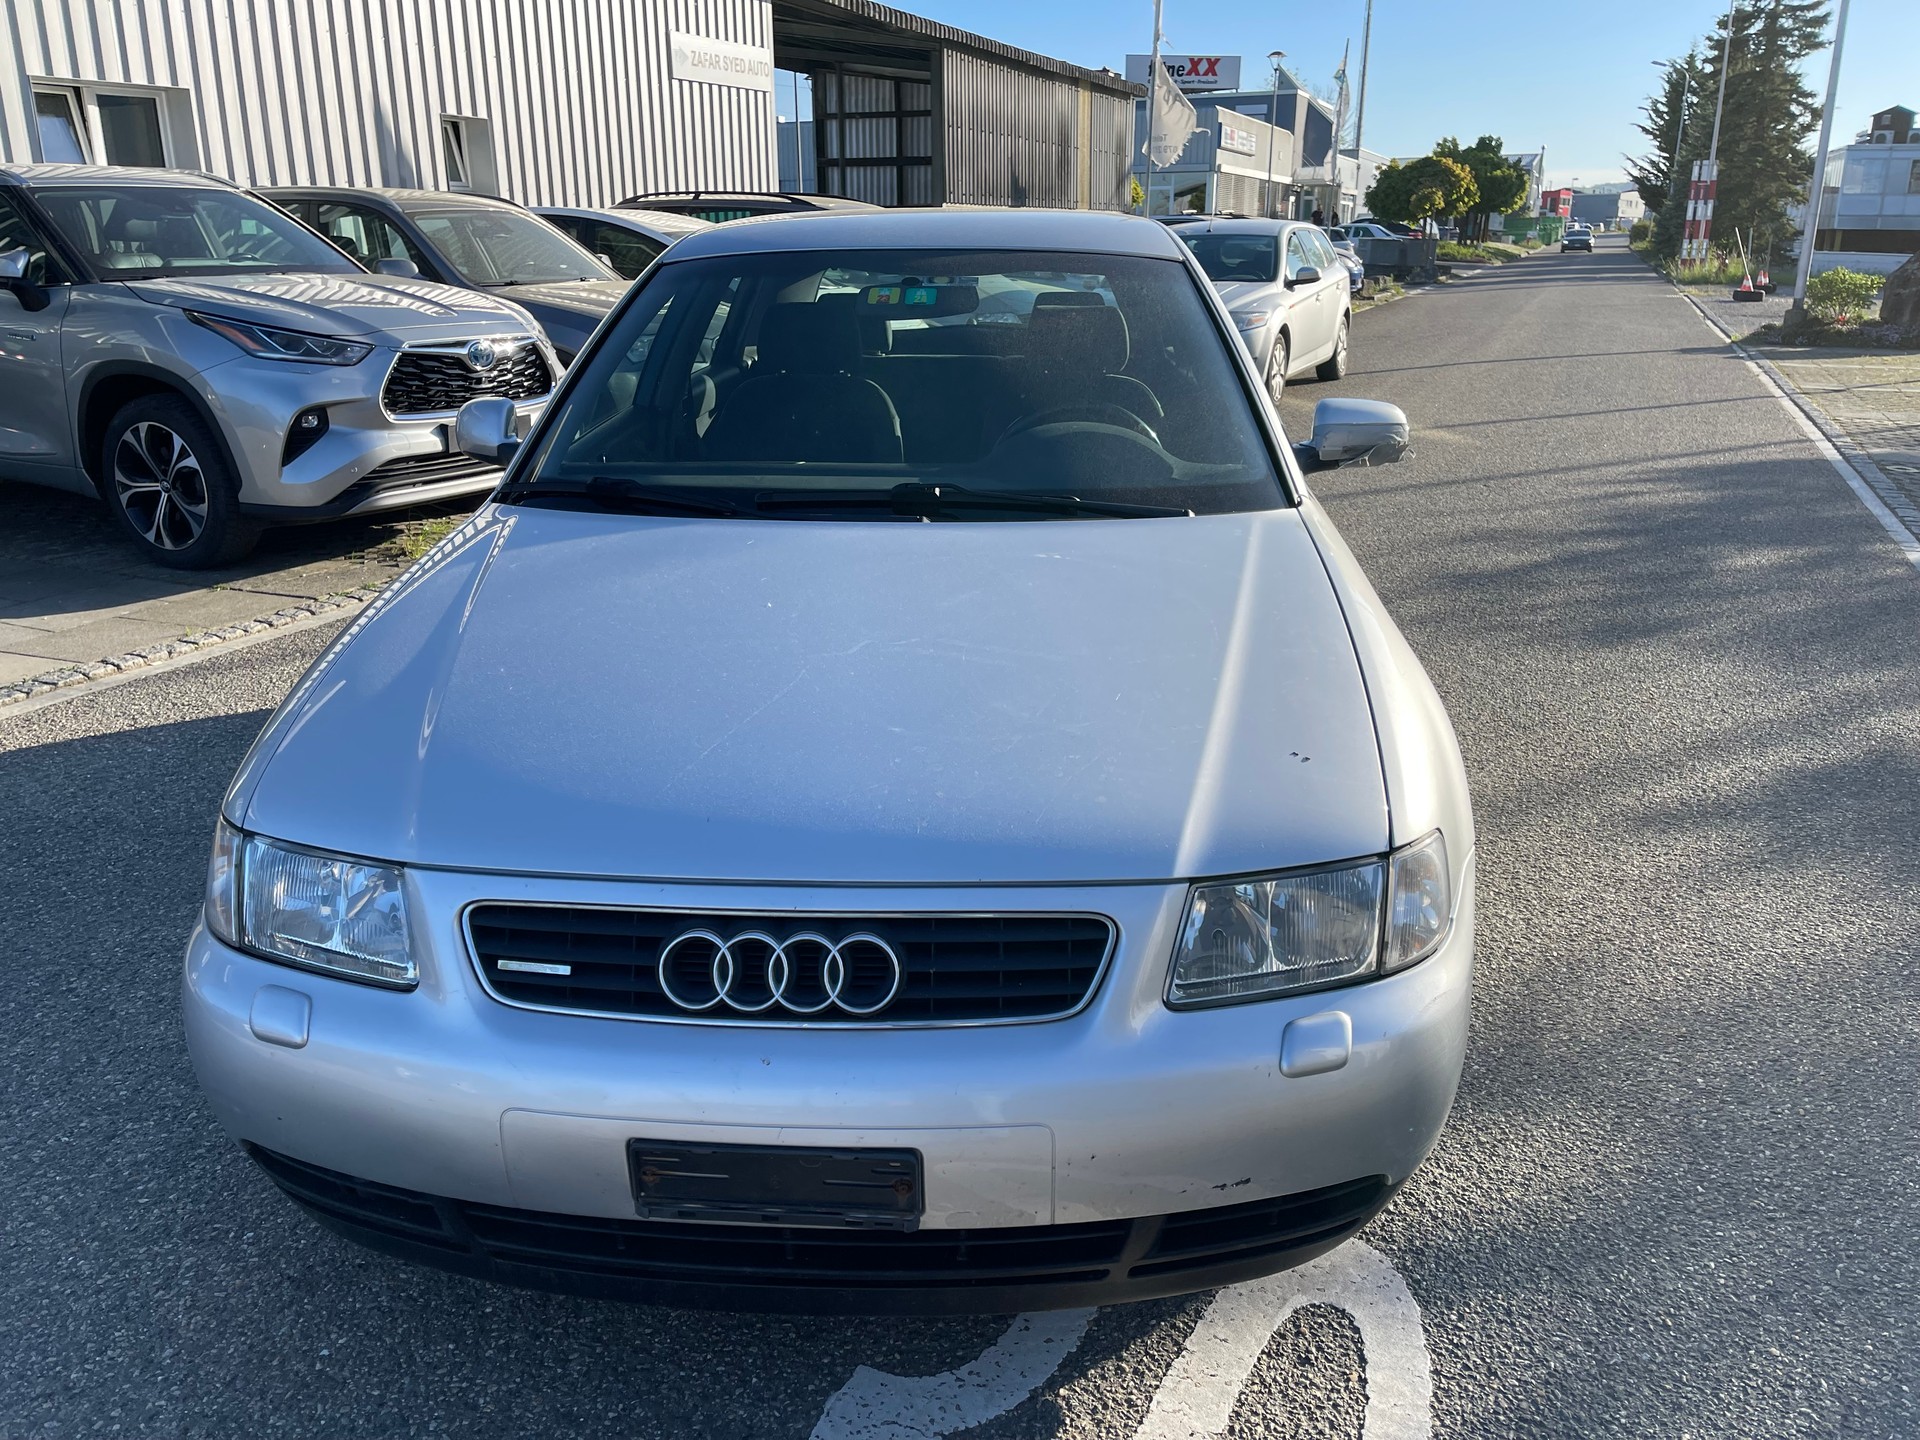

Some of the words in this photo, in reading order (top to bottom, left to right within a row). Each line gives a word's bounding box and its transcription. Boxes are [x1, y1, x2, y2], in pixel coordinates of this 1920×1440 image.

[691, 50, 721, 70] ZAFAR
[723, 55, 745, 74] SYED
[747, 59, 770, 77] AUTO
